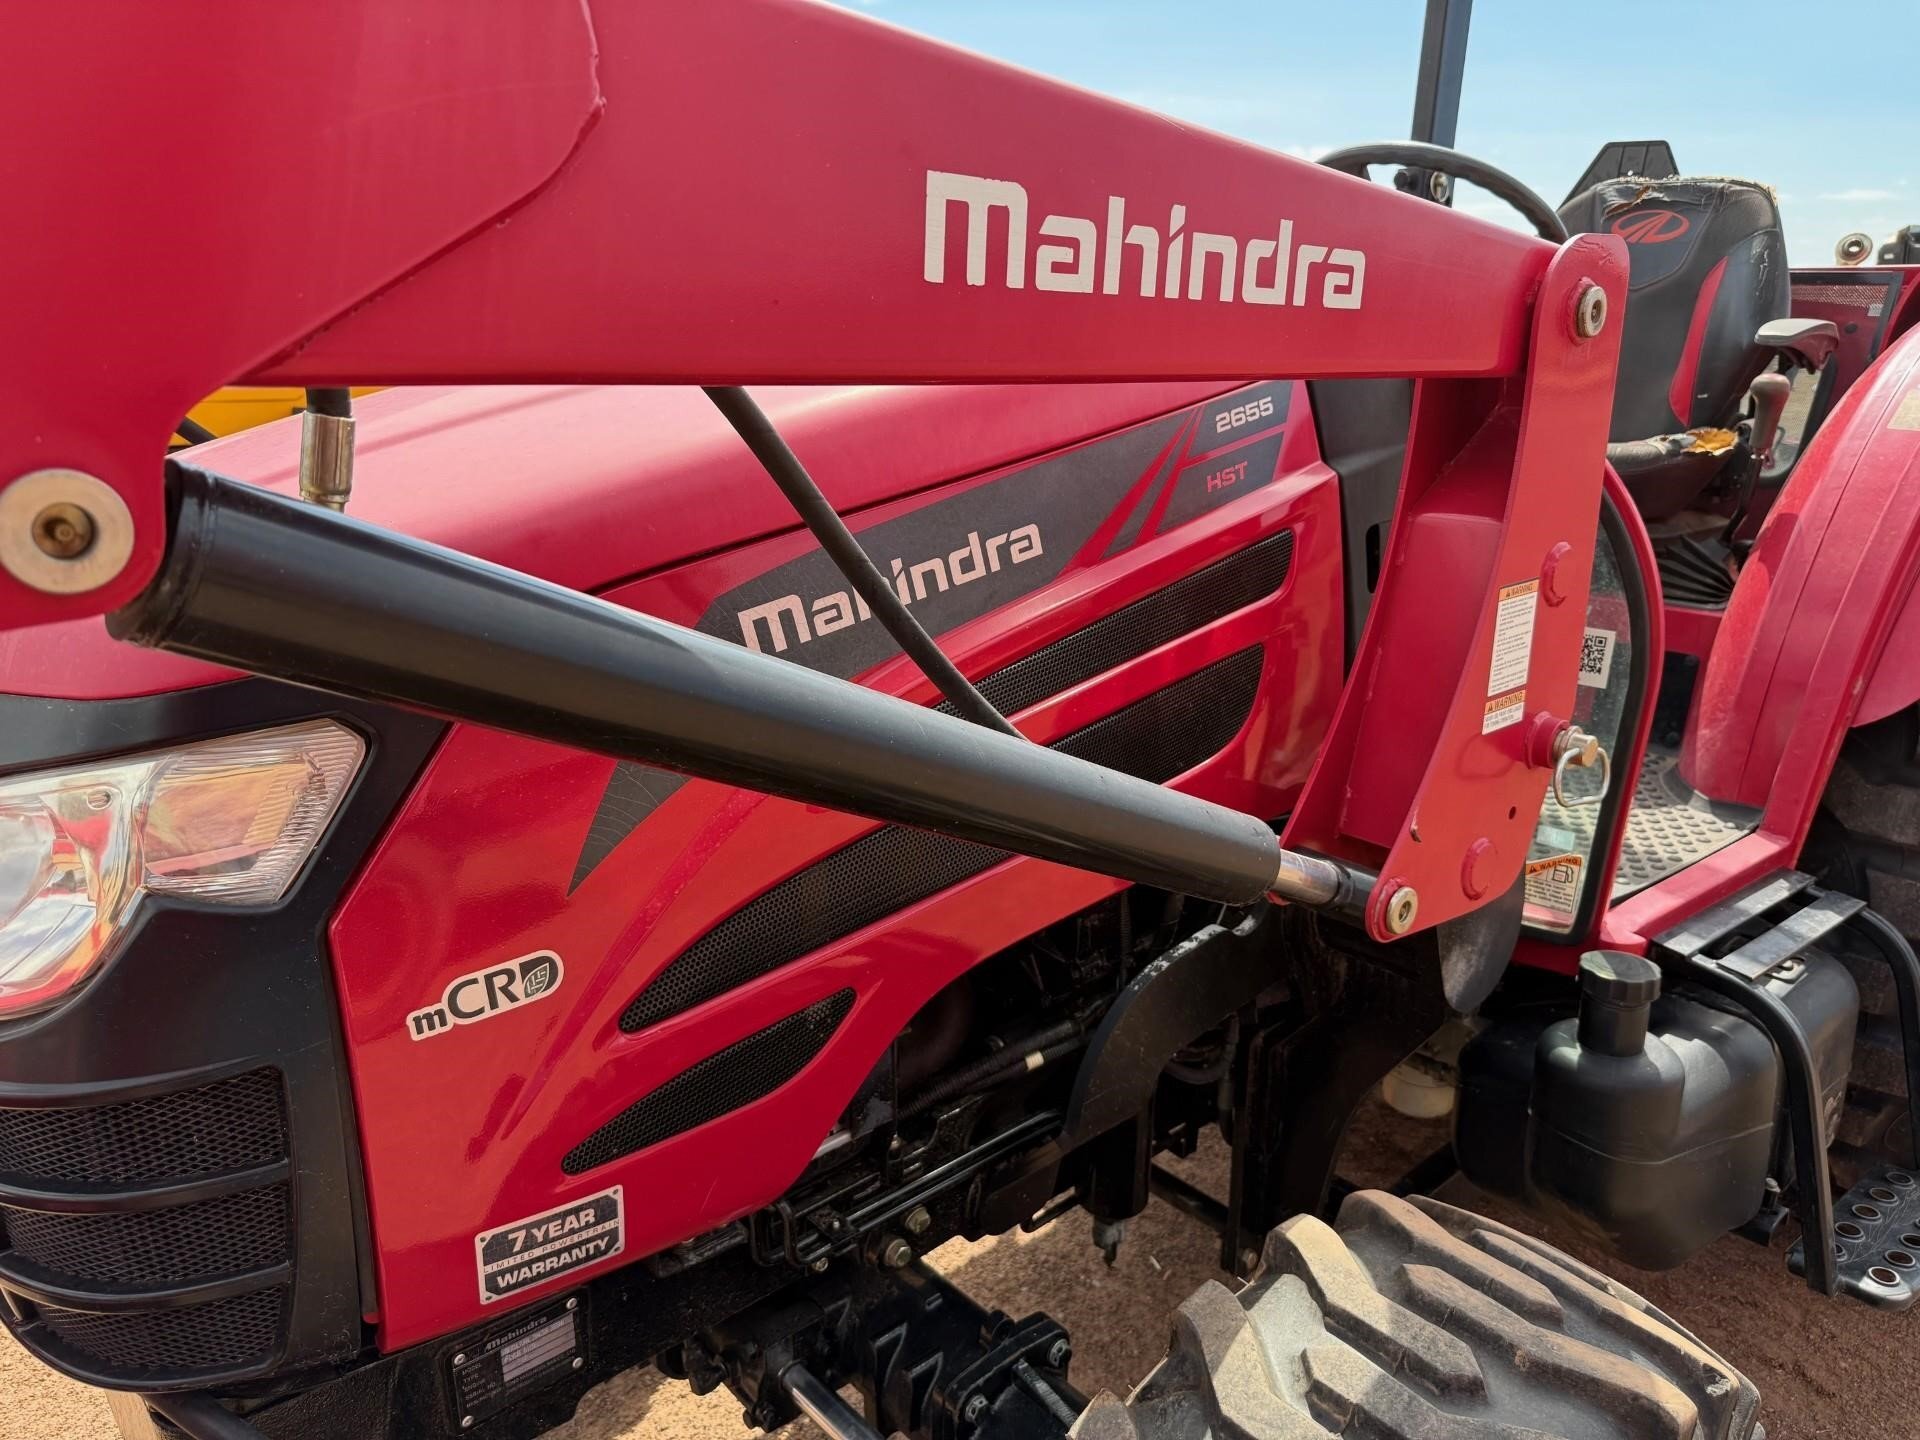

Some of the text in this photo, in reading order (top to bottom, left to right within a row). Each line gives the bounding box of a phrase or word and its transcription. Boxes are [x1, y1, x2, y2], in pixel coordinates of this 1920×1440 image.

[924, 170, 1366, 309] Mahindra
[1215, 396, 1274, 433] 2655
[1206, 460, 1248, 493] HST
[1512, 582, 1533, 595] WARNING
[1495, 691, 1523, 710] WARNING
[1540, 857, 1578, 870] WARNING
[483, 1219, 620, 1273] LIMITED POWERTRAIN
[507, 1208, 596, 1253] 7 YEAR
[496, 1236, 610, 1288] WARRANTY
